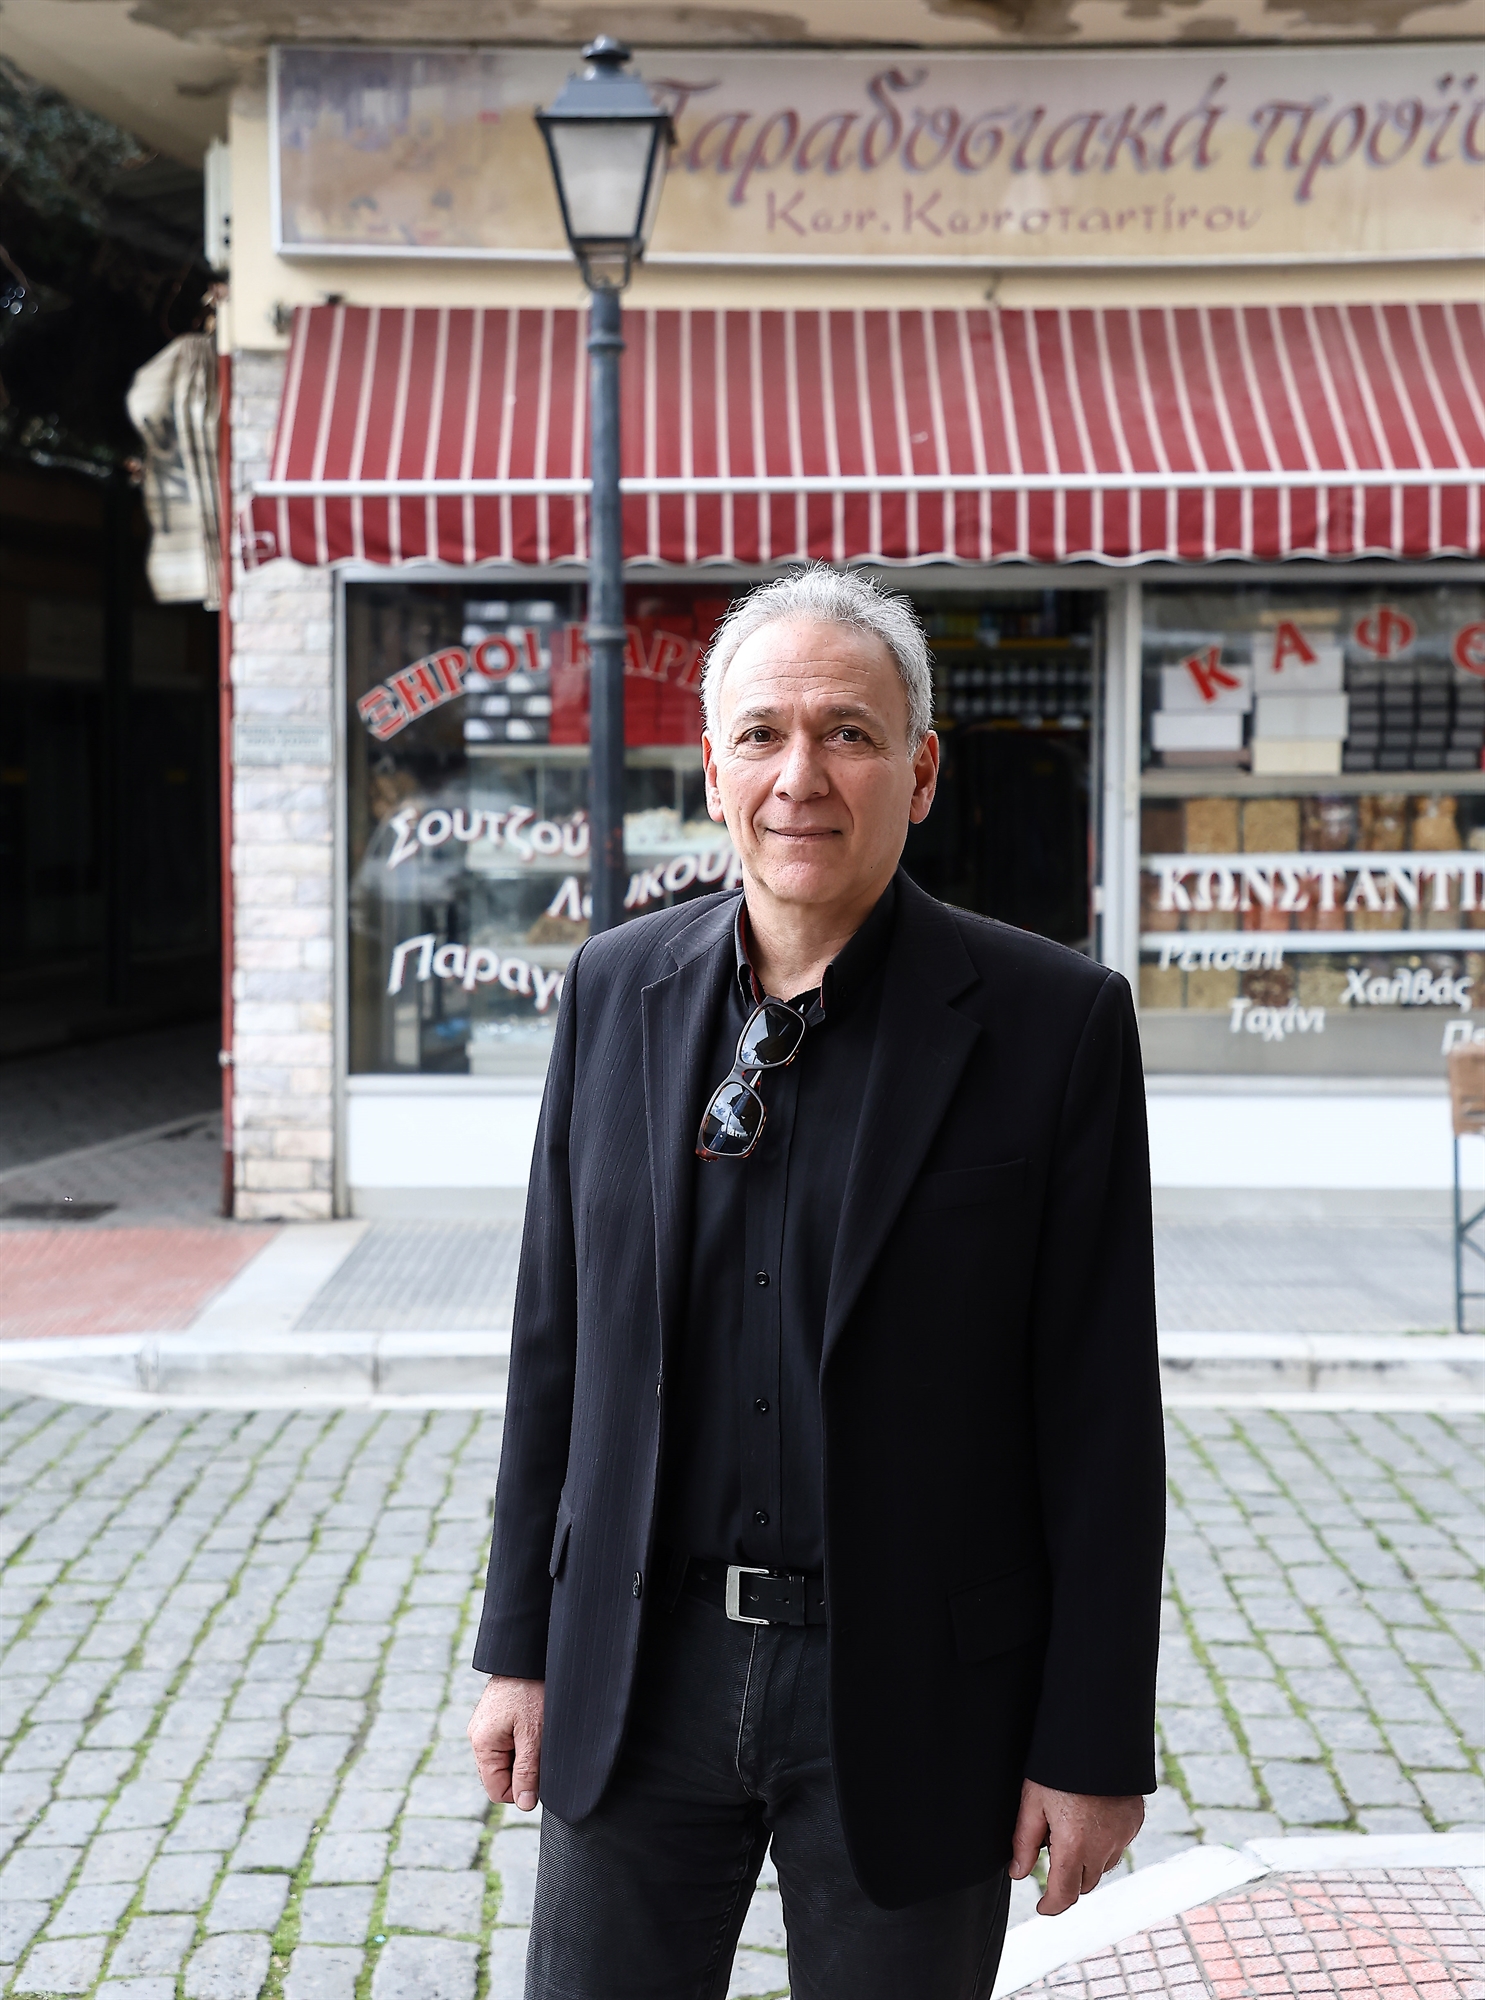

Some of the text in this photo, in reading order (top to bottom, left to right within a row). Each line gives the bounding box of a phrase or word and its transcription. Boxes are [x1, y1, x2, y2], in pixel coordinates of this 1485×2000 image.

[356, 626, 545, 742] ΞΗΡΟΙ
[385, 804, 592, 871] Σουτζού
[1158, 864, 1485, 913] ΚΩΝΣΤΑΝΤΙ
[386, 932, 566, 1015] Παραγ
[1340, 966, 1473, 1013] Χαλβάς
[1228, 996, 1327, 1042] Ταχίνι
